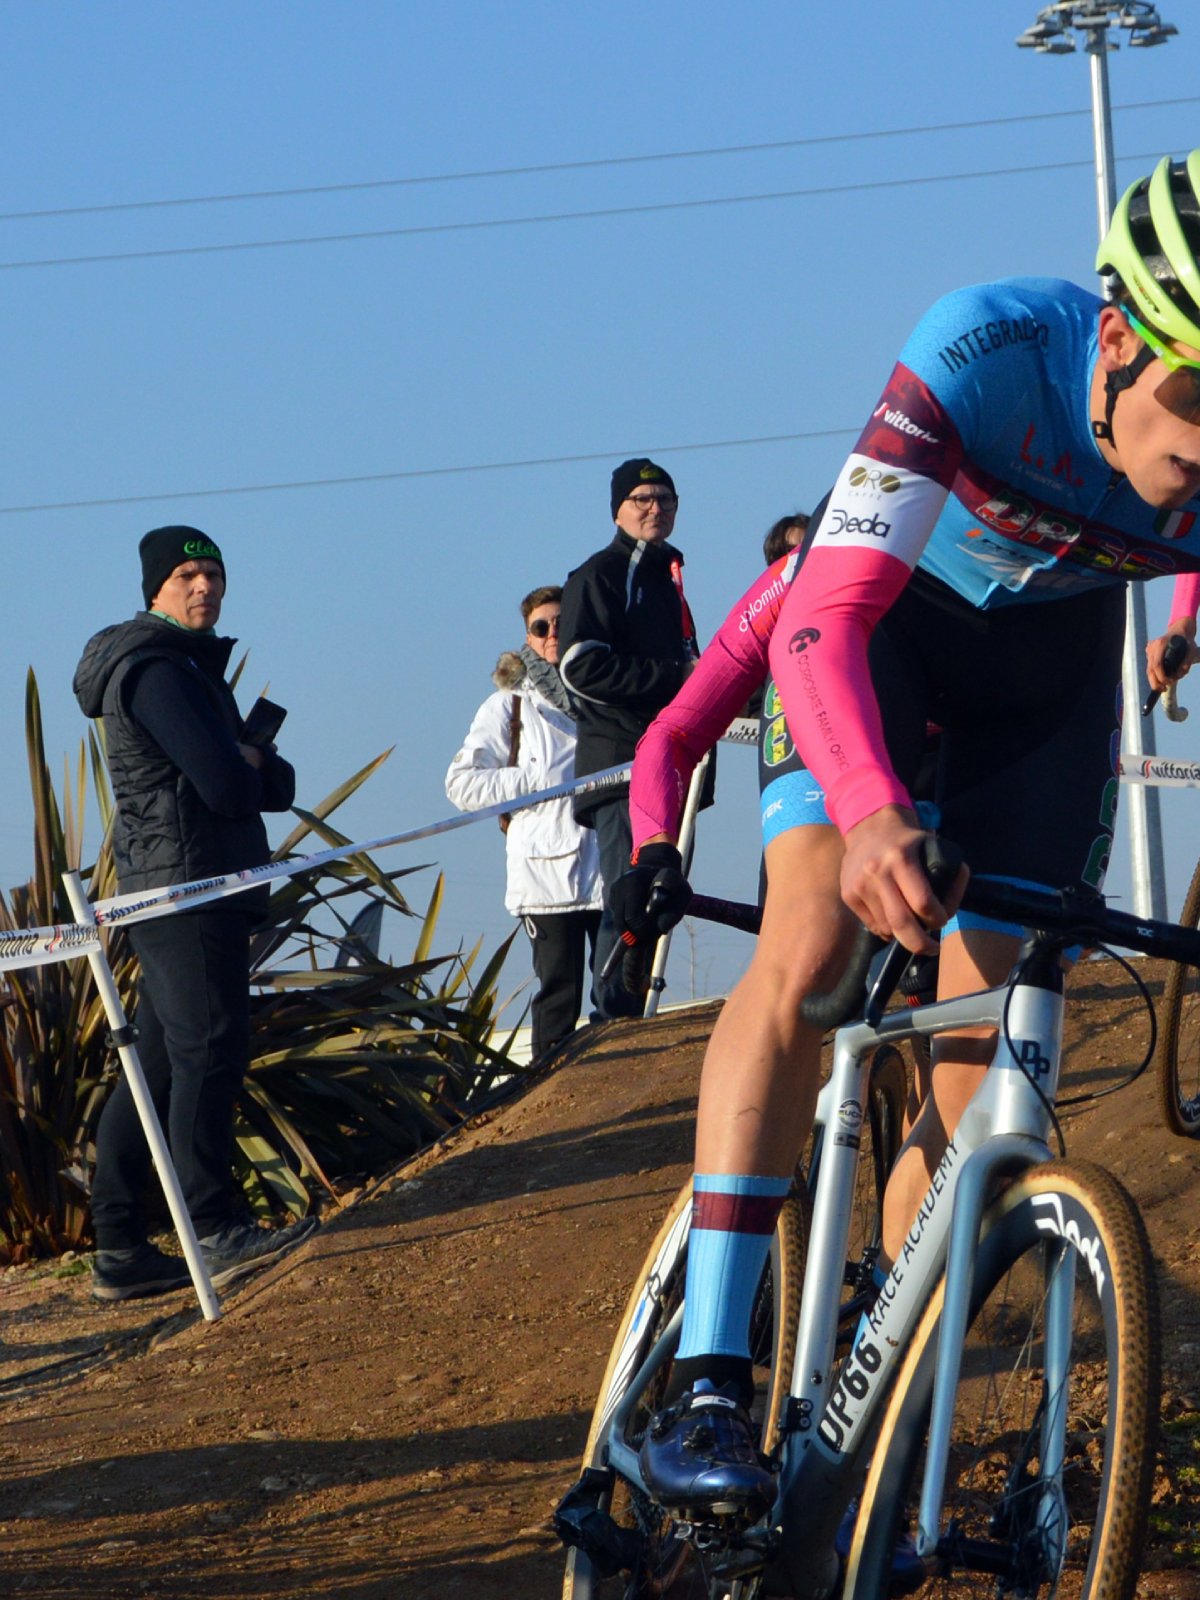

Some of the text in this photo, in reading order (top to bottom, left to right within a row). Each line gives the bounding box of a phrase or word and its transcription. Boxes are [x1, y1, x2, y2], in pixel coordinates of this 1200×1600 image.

[885, 409, 940, 444] vittoria
[828, 509, 891, 538] Deda
[739, 578, 785, 633] dolomiti
[816, 1137, 960, 1454] DP66 RACE ACADEMY
